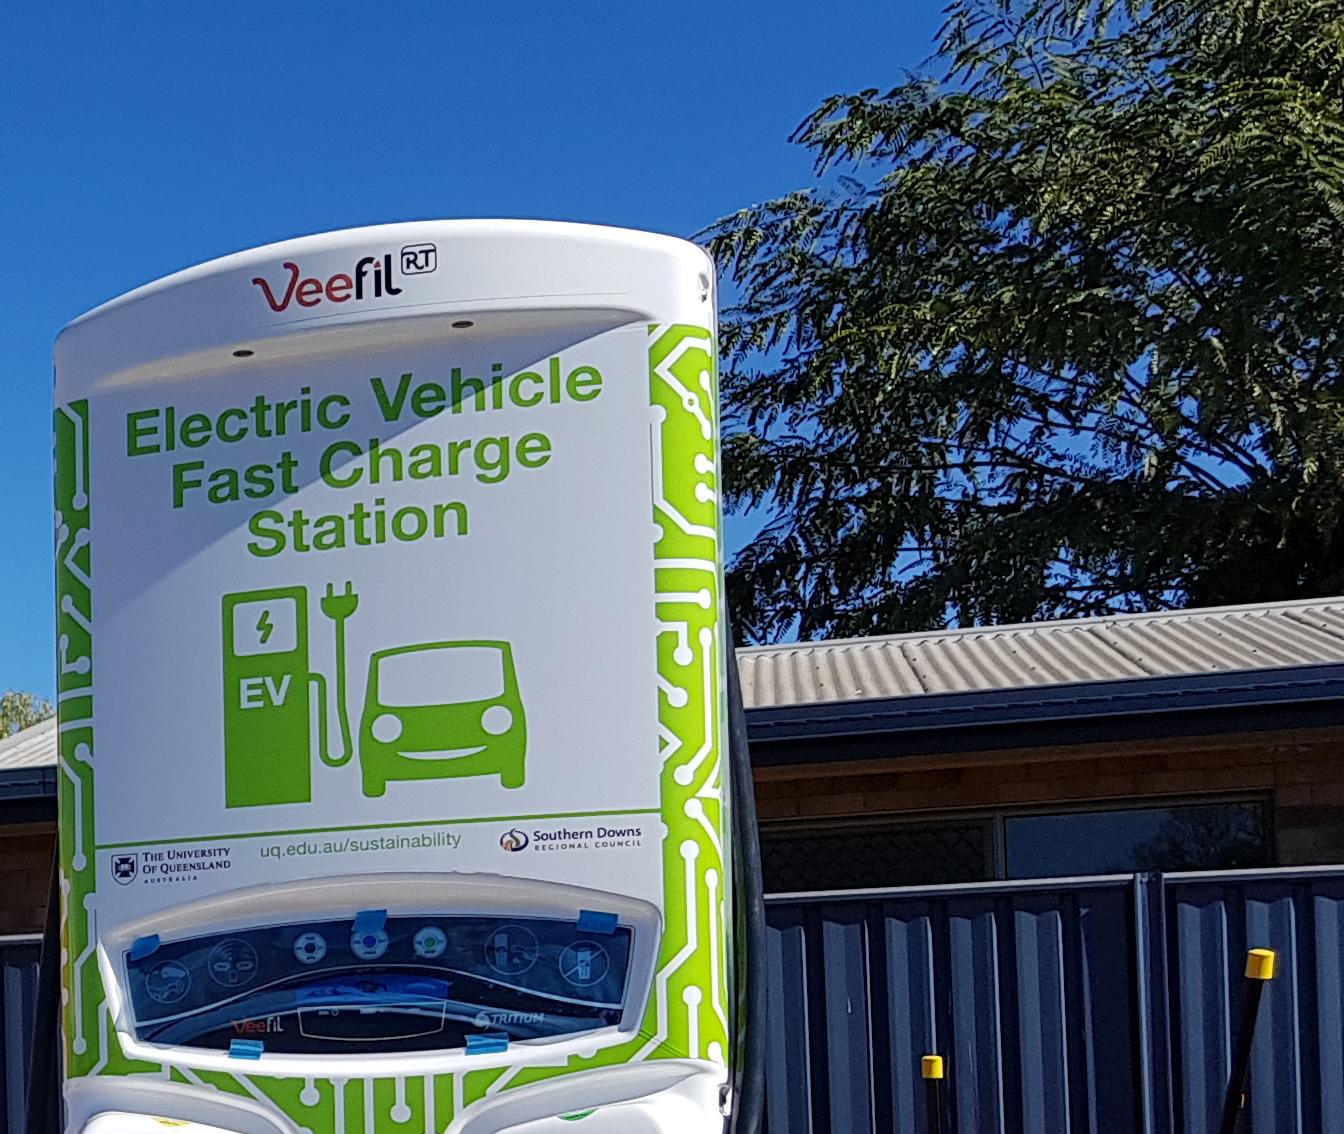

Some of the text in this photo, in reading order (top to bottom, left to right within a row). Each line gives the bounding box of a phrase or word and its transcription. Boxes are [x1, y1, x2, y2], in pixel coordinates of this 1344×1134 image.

[251, 247, 437, 312] Veefil RT
[124, 357, 604, 458] Electric Vehicle
[171, 431, 553, 509] Fast Charge
[246, 498, 470, 558] Station
[238, 675, 292, 709] EV
[260, 831, 462, 860] uq.edu.au/sustainability
[533, 826, 642, 842] Southern Downs
[534, 840, 642, 851] REGIONAL COUNCIL
[144, 875, 197, 884] AUSTRALIA
[489, 1013, 545, 1025] TRITIUM
